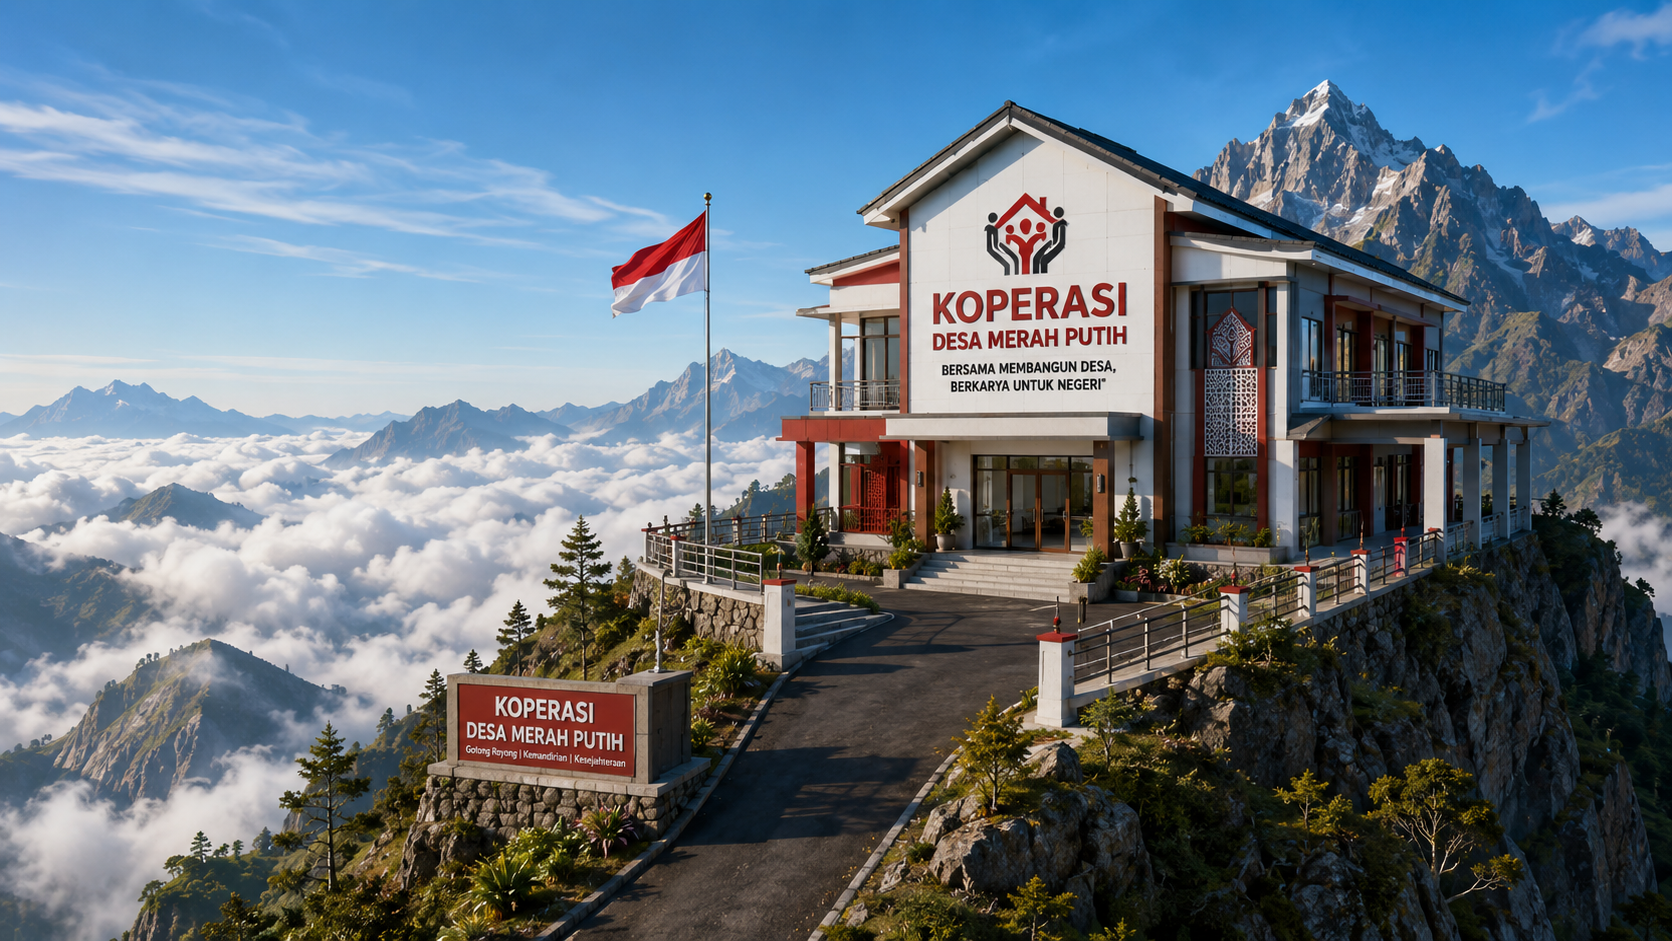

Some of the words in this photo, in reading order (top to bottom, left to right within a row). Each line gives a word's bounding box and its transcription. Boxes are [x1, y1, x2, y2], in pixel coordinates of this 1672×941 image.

[933, 282, 1127, 324] KOPERASI
[933, 332, 982, 351] DESA
[988, 328, 1058, 349] MERAH
[1066, 326, 1127, 346] PUTIH
[942, 363, 995, 375] BERSAMA
[999, 361, 1077, 374] MEMBANGUN
[1081, 360, 1116, 374] DESA,
[951, 380, 1010, 392] BERKARYA
[1014, 379, 1053, 391] UNTUK
[495, 696, 594, 724] KOPERASI
[467, 722, 506, 741] DESA
[512, 725, 568, 746] MERAH
[574, 731, 624, 751] PUTIH
